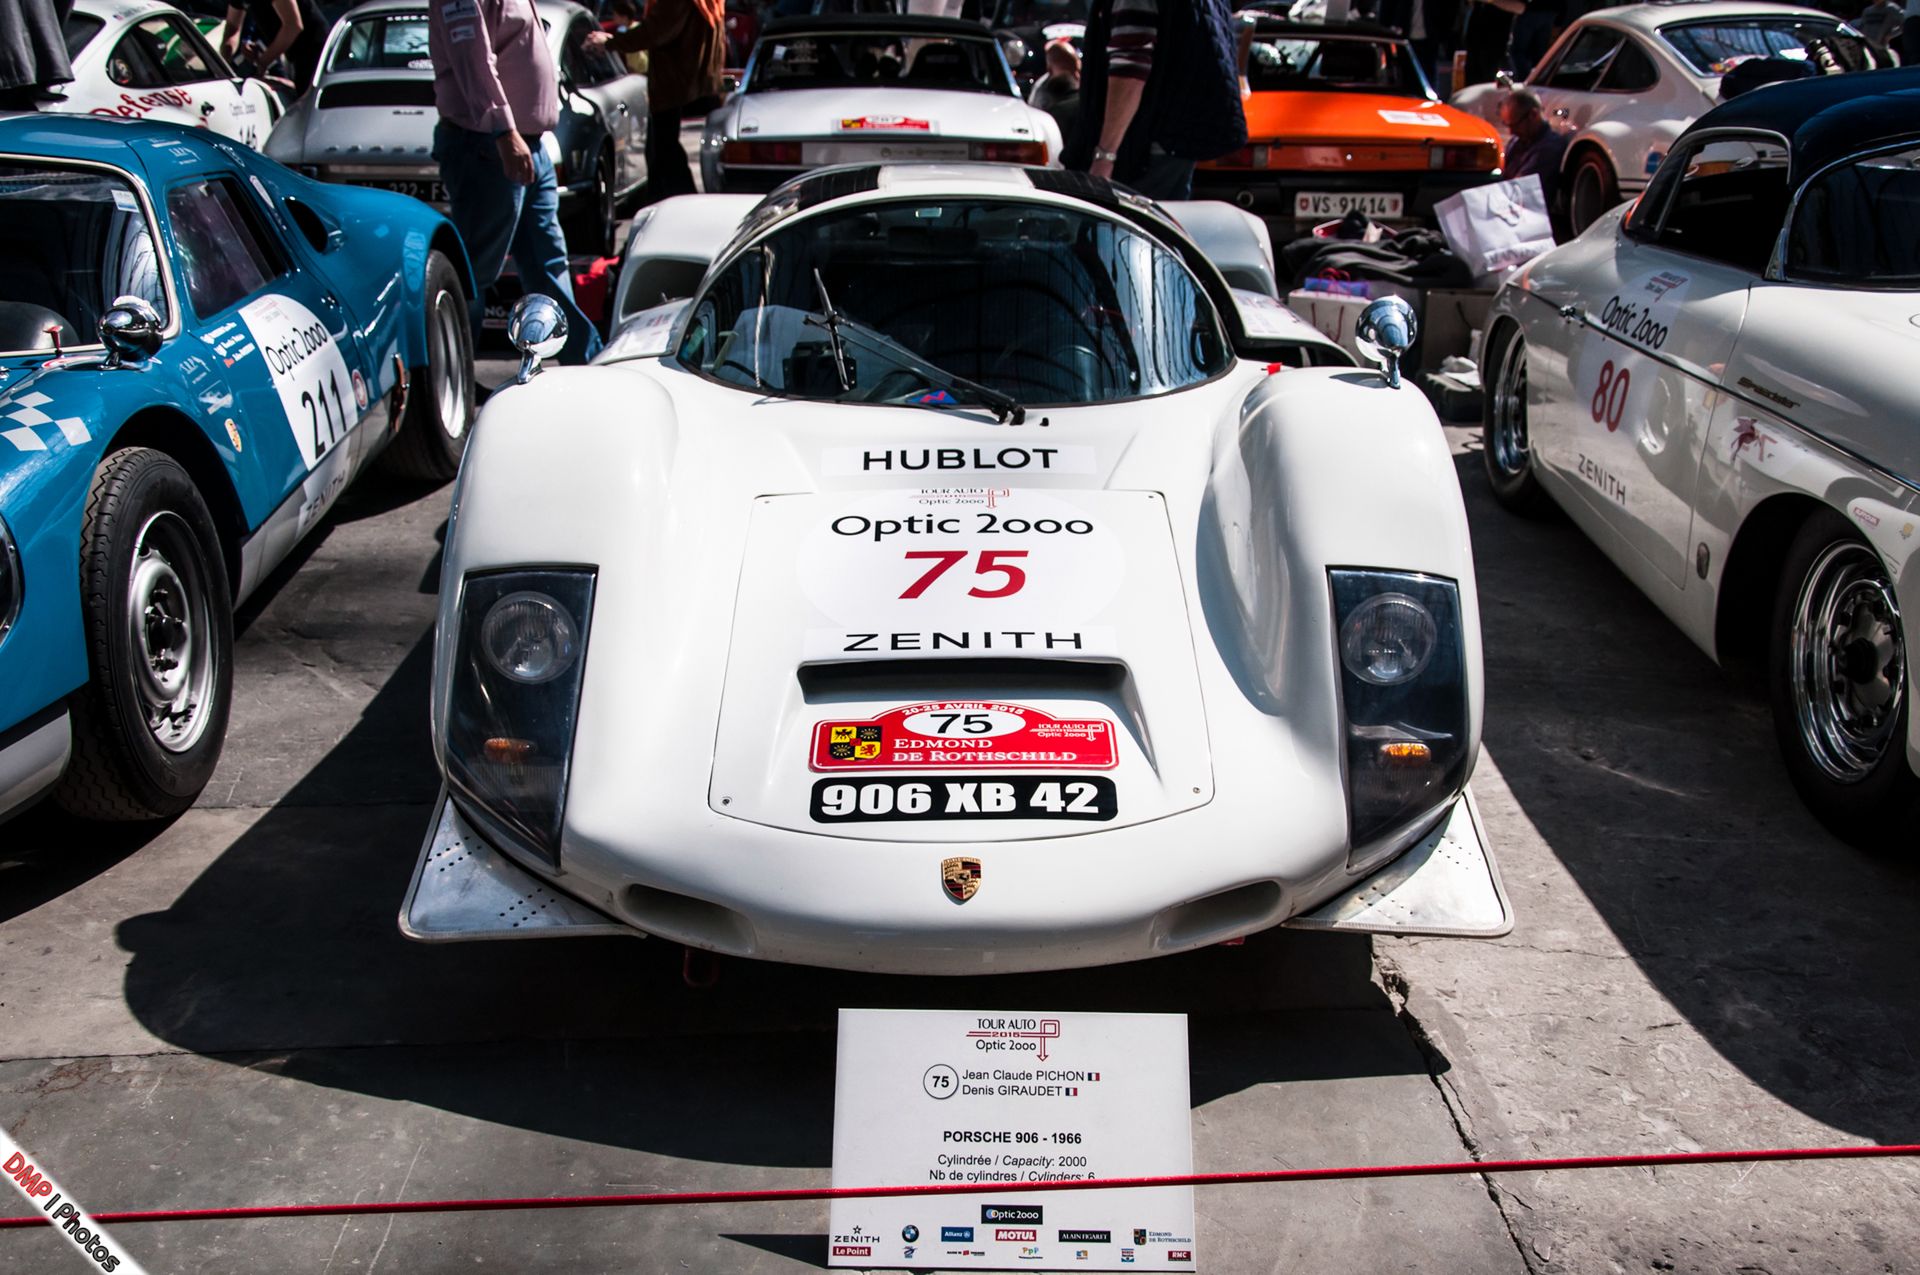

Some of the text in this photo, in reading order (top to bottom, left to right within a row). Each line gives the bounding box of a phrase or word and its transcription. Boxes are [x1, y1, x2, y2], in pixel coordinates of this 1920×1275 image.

[1601, 295, 1637, 335] Optic
[265, 335, 304, 381] Optic
[1591, 360, 1630, 432] 80
[302, 369, 347, 459] 211
[862, 448, 1058, 470] HUBLOT
[1578, 453, 1626, 505] ZENITH
[831, 514, 960, 541] Optic
[898, 550, 1029, 599] 75
[843, 632, 1082, 651] ZENITH
[990, 703, 1026, 715] 2015
[930, 713, 993, 734] 75
[894, 739, 993, 749] EDMOND
[893, 750, 1077, 762] DE ROTHSCHILD
[821, 782, 1099, 816] 906 XB 42
[977, 1018, 1036, 1030] TOUR AUTO
[975, 1039, 1005, 1052] Optic
[932, 1075, 949, 1088] 75
[962, 1069, 1084, 1081] Jean Claude PICHON
[962, 1085, 1062, 1097] Denis GIRAUDET
[943, 1131, 1011, 1143] PORSCHE
[1015, 1132, 1039, 1144] 906
[1052, 1133, 1082, 1144] 1966
[937, 1153, 991, 1168] Cylindrée
[1002, 1155, 1054, 1169] Capacity:
[1058, 1156, 1087, 1167] 2000
[929, 1169, 945, 1180] Nb
[949, 1170, 963, 1181] de
[967, 1170, 1017, 1183] cylindres
[991, 1209, 1015, 1220] Optic
[834, 1235, 880, 1243] ZENITH
[997, 1231, 1035, 1240] MOTUL
